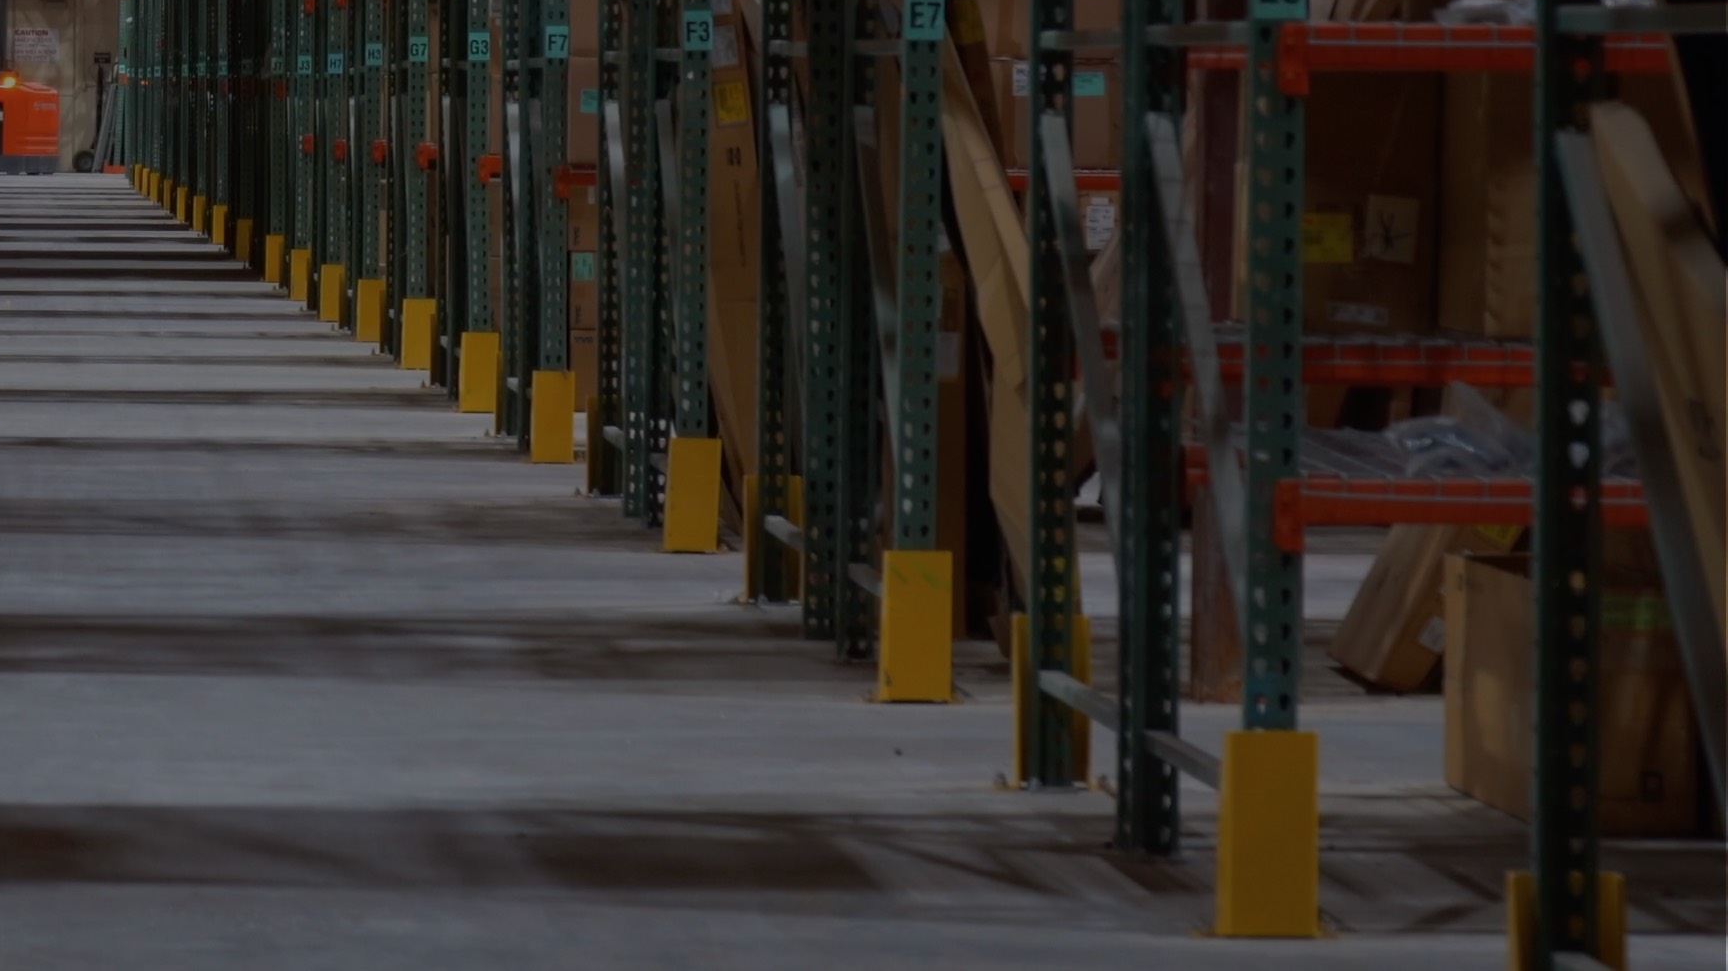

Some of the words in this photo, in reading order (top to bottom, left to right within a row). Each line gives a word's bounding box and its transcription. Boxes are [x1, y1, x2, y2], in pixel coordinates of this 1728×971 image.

[910, 2, 941, 29] E7
[686, 21, 710, 42] F3
[470, 39, 489, 55] G3
[548, 34, 567, 51] F7
[368, 48, 381, 61] H3
[410, 43, 427, 57] G7
[272, 60, 282, 71] J7
[299, 60, 310, 71] J3
[329, 59, 342, 69] H7
